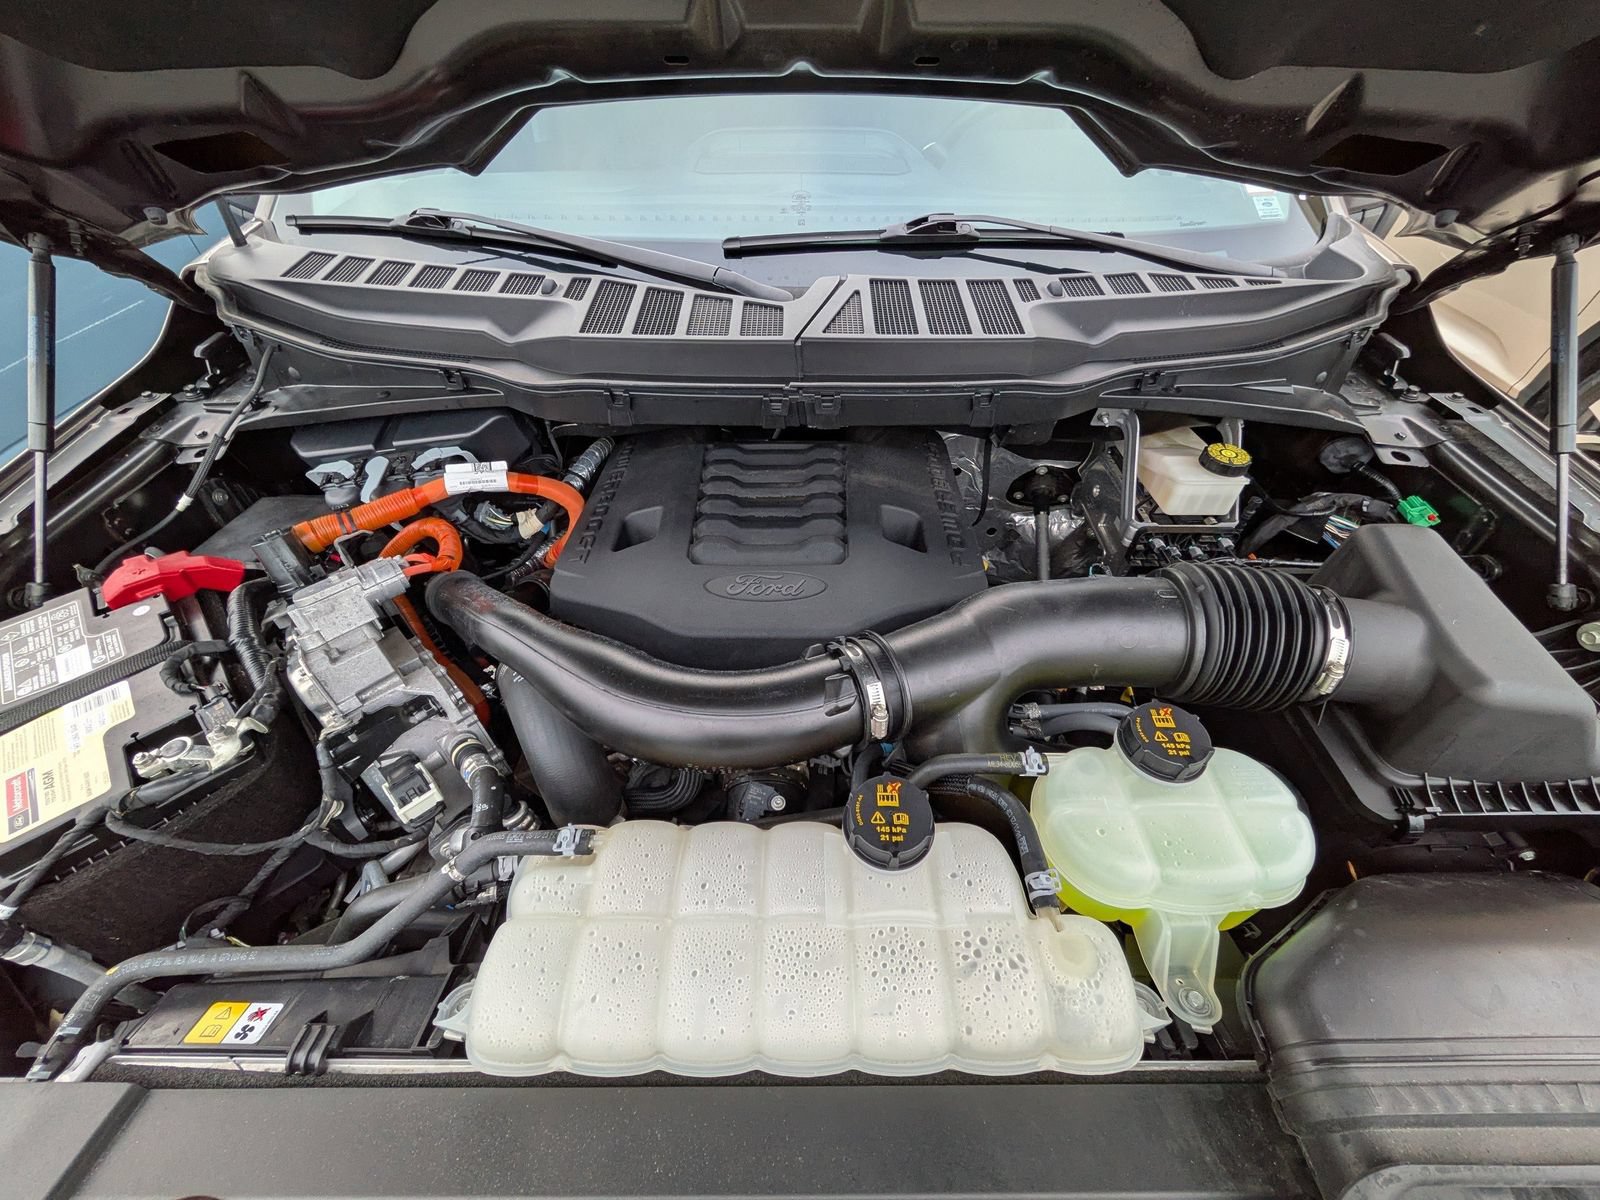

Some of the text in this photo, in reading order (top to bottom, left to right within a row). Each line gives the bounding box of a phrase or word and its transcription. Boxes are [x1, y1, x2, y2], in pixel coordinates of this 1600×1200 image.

[726, 574, 807, 597] Ford
[42, 769, 56, 791] AGM
[875, 825, 908, 834] 145 kPa
[892, 834, 904, 843] psi
